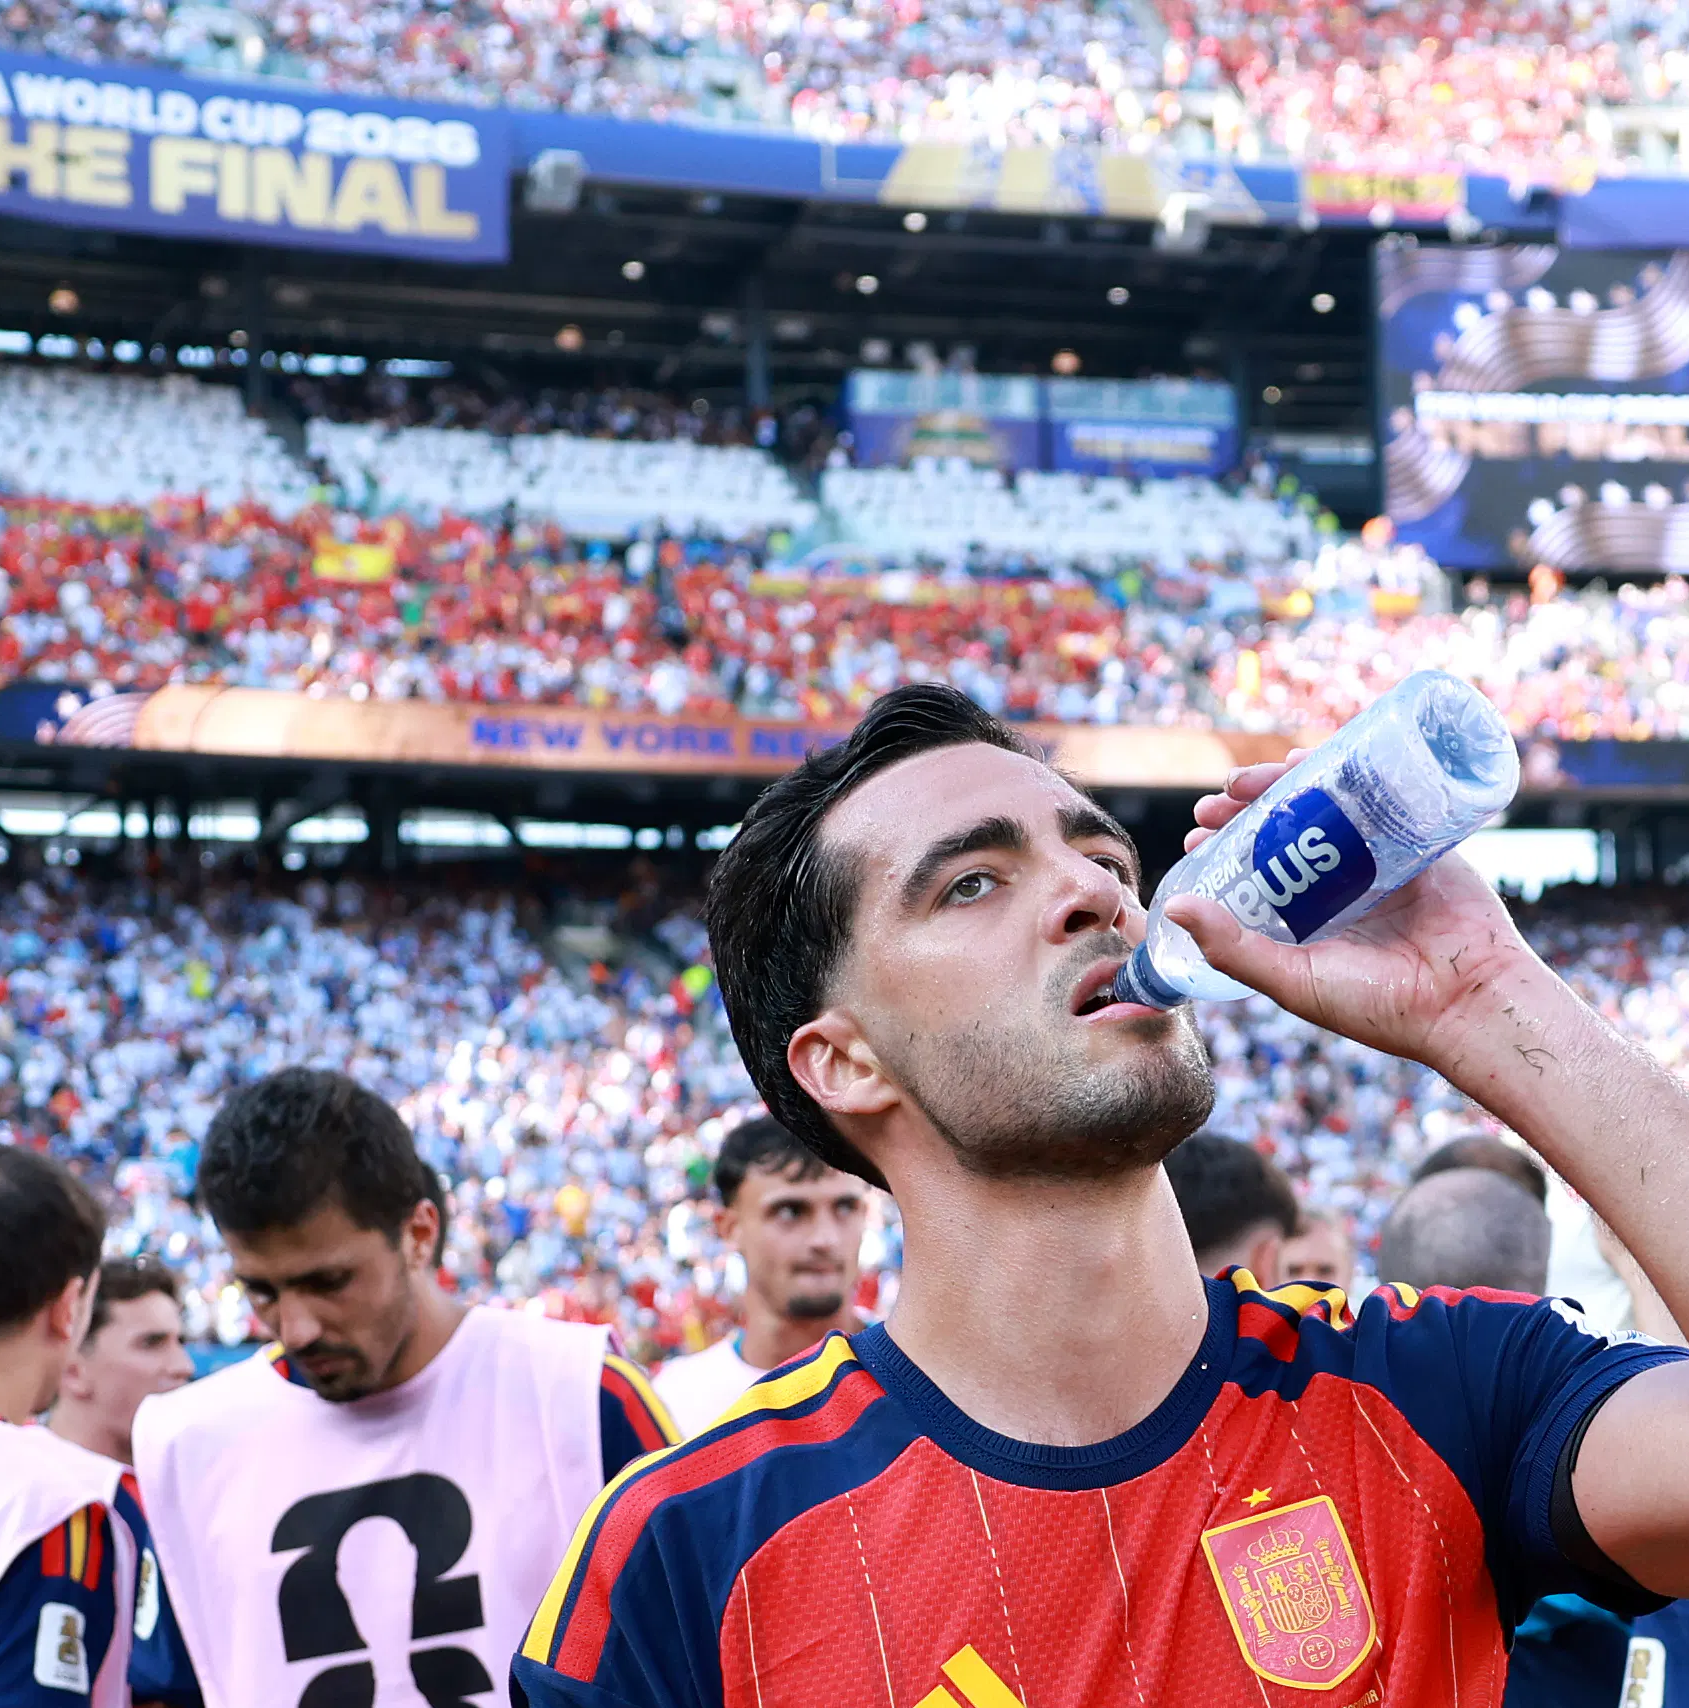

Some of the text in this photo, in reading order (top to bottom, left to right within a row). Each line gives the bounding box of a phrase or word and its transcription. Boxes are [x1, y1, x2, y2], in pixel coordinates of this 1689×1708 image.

[12, 71, 199, 134] WORLD
[201, 95, 305, 146] CUP
[306, 108, 479, 167] 2026
[150, 134, 479, 239] FINAL
[472, 717, 582, 751] NEW
[602, 722, 736, 756] YORK
[1188, 856, 1243, 900] wate
[1218, 827, 1341, 927] sma
